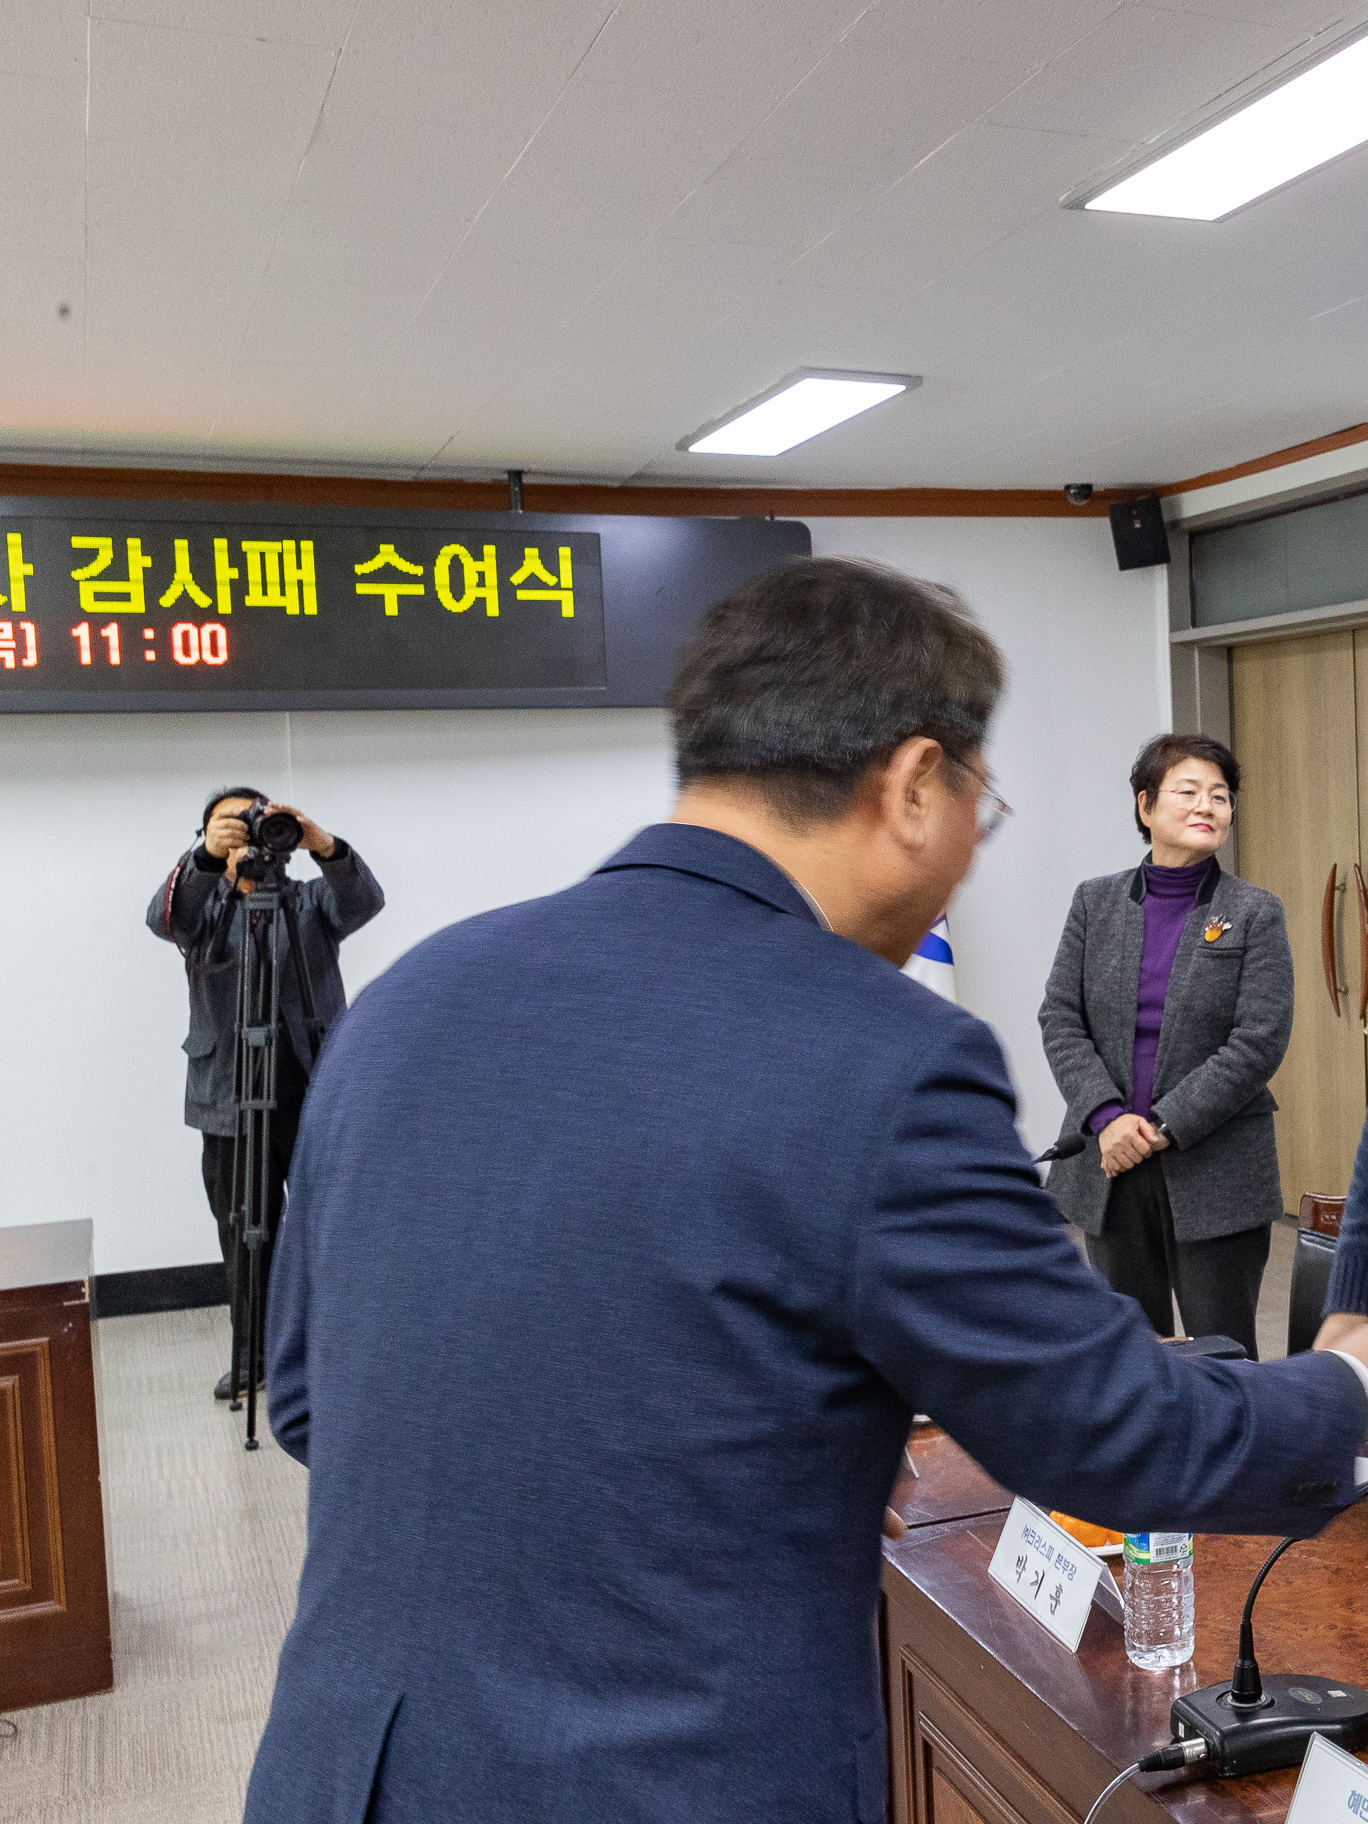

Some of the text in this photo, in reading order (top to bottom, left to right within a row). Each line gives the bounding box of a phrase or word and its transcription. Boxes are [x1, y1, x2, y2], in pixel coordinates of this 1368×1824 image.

[70, 535, 318, 615] 감사패
[354, 543, 575, 618] 수여식
[1054, 1552, 1078, 1581] 본부장
